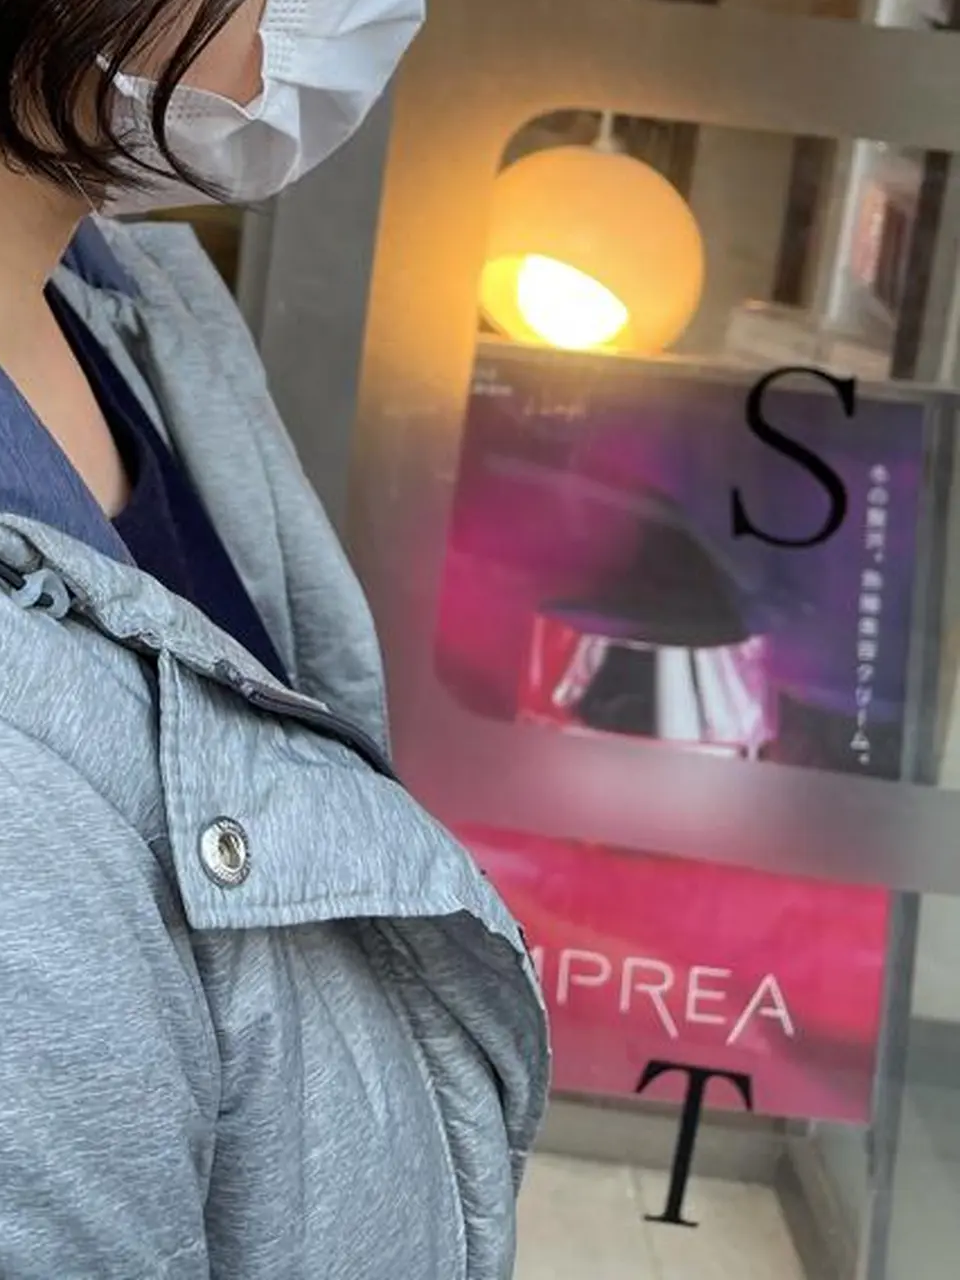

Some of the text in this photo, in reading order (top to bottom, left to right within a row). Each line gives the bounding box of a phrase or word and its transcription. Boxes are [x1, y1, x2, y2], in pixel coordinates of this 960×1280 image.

[730, 367, 858, 548] S
[530, 946, 795, 1046] PREA
[634, 1060, 753, 1227] T
